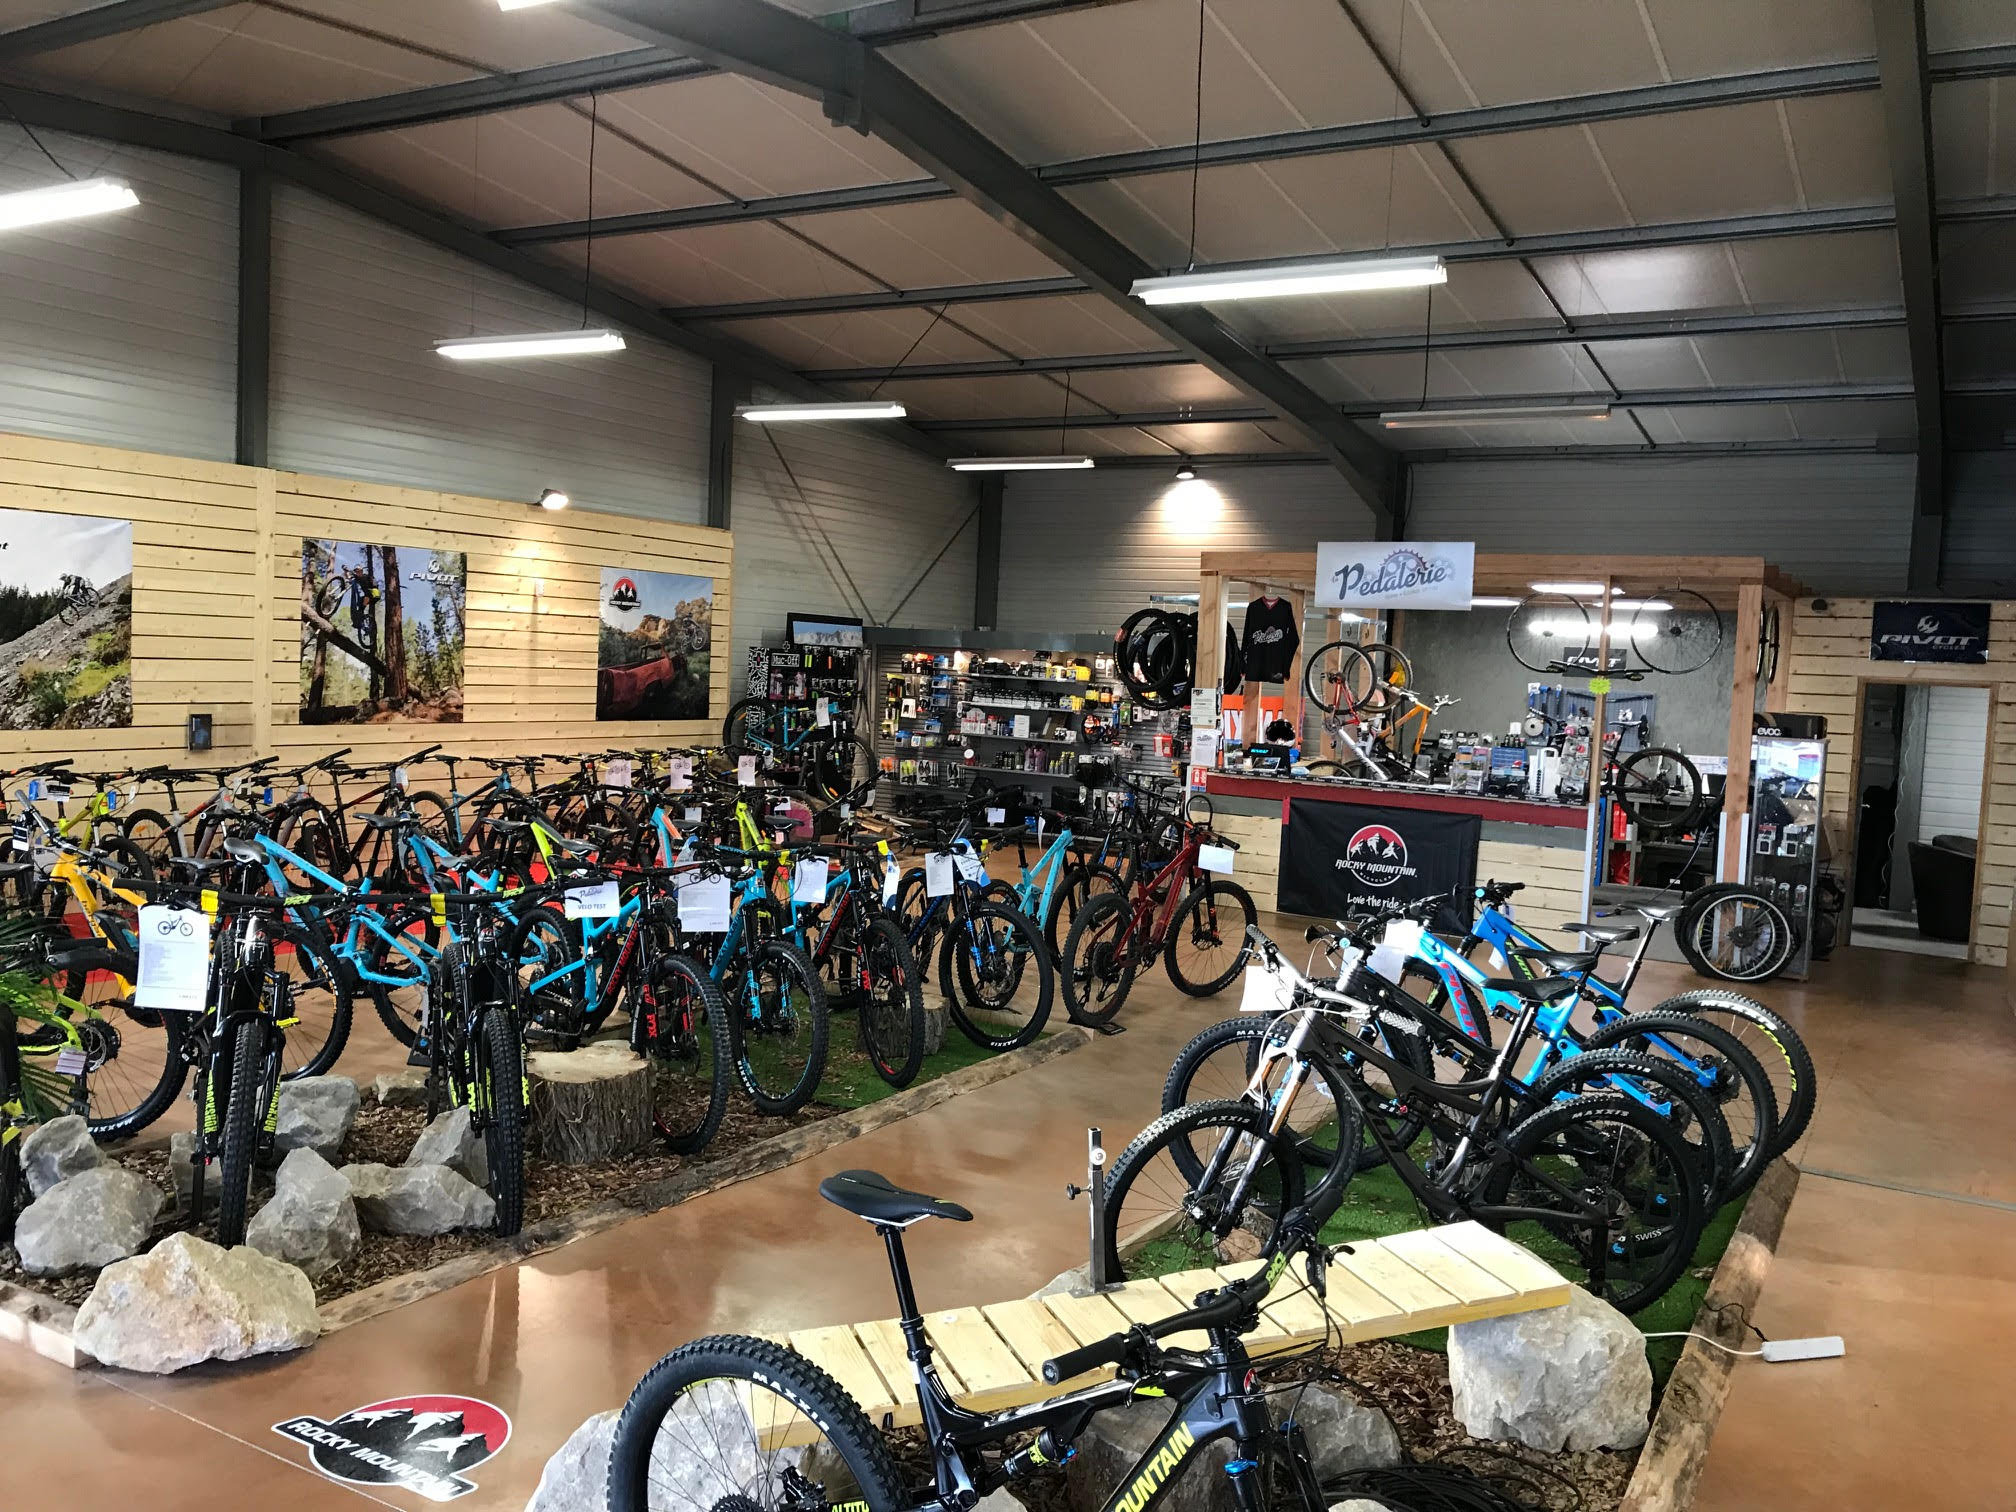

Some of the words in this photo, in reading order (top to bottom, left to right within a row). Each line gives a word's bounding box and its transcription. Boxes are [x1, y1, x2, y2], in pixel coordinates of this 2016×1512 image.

[409, 572, 459, 582] PIVOT
[1335, 562, 1447, 600] Pedalerie
[1880, 634, 1979, 646] PIVOT
[772, 654, 799, 667] Muc-Off
[1566, 656, 1622, 668] PIVT
[1334, 859, 1367, 871] ROCKY
[1366, 861, 1417, 877] MOUNTAIN
[1346, 893, 1366, 905] Love
[1365, 895, 1383, 907] the
[1382, 896, 1401, 909] ride
[646, 1012, 659, 1039] FOX
[1594, 1063, 1652, 1074] MAXXIS
[1196, 1114, 1251, 1126] MAXXIS
[1571, 1108, 1630, 1120] MAXXIS
[1634, 1227, 1663, 1242] SWISS
[752, 1370, 831, 1433] MAXXIS
[286, 1420, 360, 1450] ROCKY
[1113, 1420, 1196, 1512] OUNTAIN
